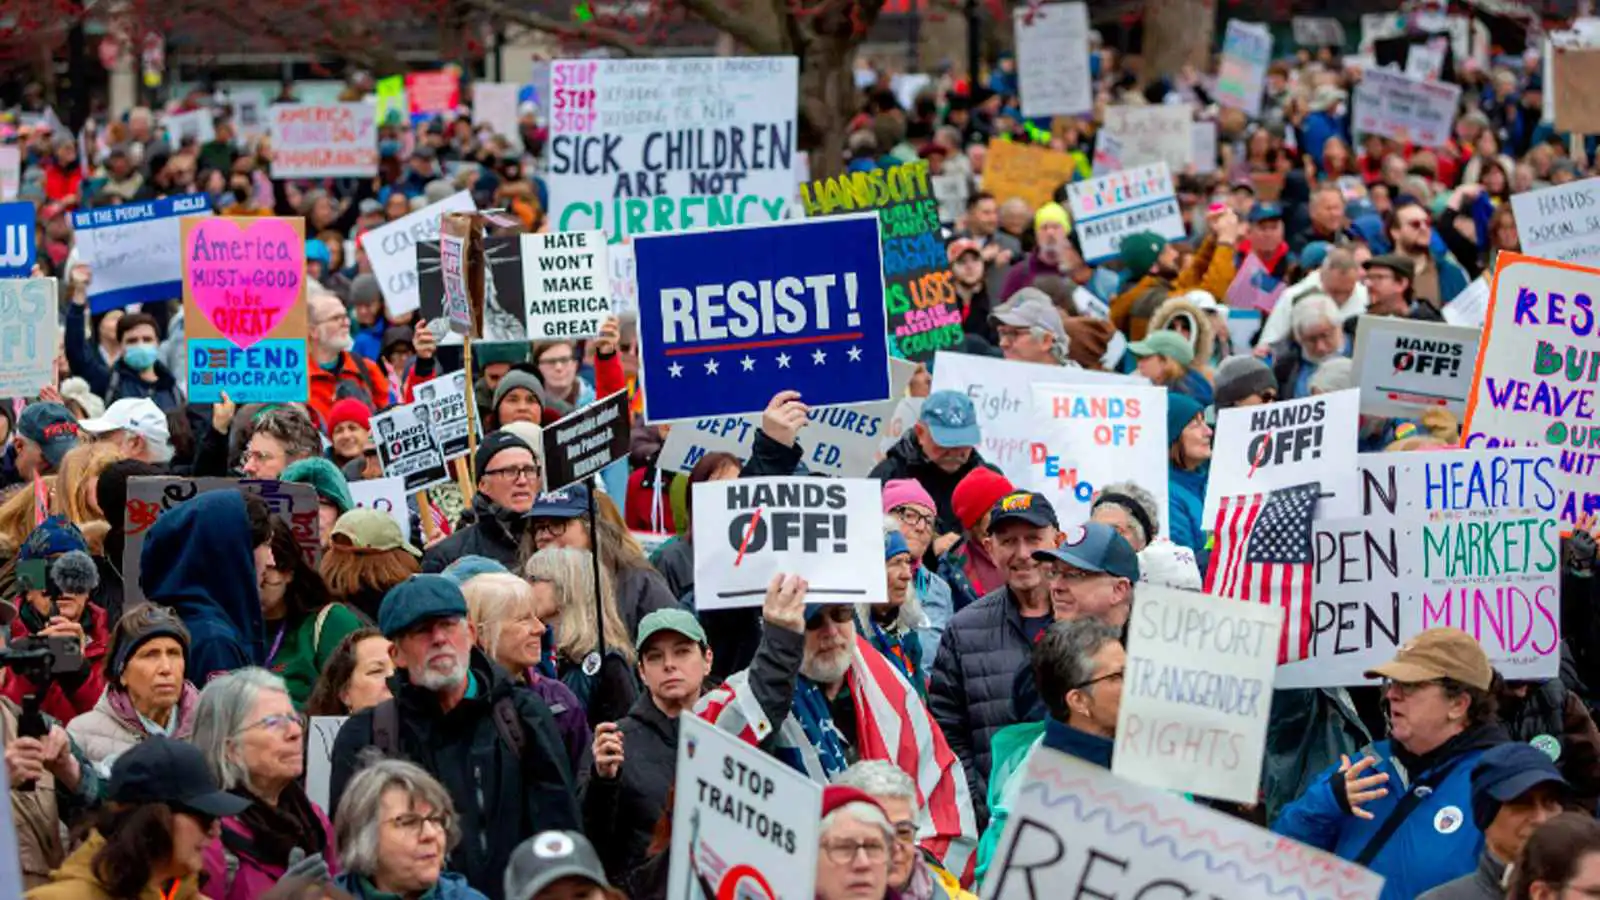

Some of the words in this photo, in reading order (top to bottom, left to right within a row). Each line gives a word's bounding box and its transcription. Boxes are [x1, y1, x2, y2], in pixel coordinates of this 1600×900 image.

[553, 62, 598, 86] STOP
[553, 89, 597, 110] STOP
[553, 112, 597, 133] STOP
[552, 132, 623, 175] SICK
[643, 120, 793, 171] CHILDREN
[614, 172, 667, 197] ARE
[690, 172, 746, 196] NOT
[800, 168, 889, 215] HANDS
[888, 159, 929, 201] OFF
[94, 208, 113, 224] THE
[115, 203, 155, 221] PEOPLE
[1126, 204, 1175, 226] AMERICA
[1537, 188, 1596, 216] HANDS
[559, 195, 785, 244] CURRENCY
[192, 227, 293, 262] America
[544, 233, 587, 250] HATE
[538, 253, 594, 271] WON'T
[193, 268, 238, 288] MUST
[252, 269, 298, 288] GOOD
[543, 276, 593, 292] MAKE
[225, 290, 240, 306] to
[244, 289, 262, 306] be
[530, 296, 610, 316] AMERICA
[660, 272, 862, 344] RESIST!
[212, 307, 280, 337] GREAT
[1513, 286, 1600, 338] RES
[543, 319, 599, 336] GREAT
[902, 323, 965, 355] COURTS
[194, 347, 299, 369] DEFEND
[1395, 337, 1464, 356] HANDS
[191, 371, 303, 386] DEMOCRACY
[1392, 352, 1462, 378] OFF!
[430, 393, 463, 409] HANDS
[967, 384, 1022, 420] Fight
[1052, 397, 1141, 418] HANDS
[1486, 377, 1595, 420] WEAVE
[806, 407, 882, 438] UTURES
[1250, 400, 1326, 431] HANDS
[386, 423, 425, 442] HANDS
[391, 435, 428, 456] OFF!
[1094, 424, 1142, 446] OFF
[1545, 421, 1600, 448] OUR
[813, 443, 843, 469] ED.
[1247, 425, 1324, 468] OFF!
[1029, 442, 1100, 503] DEMO
[1425, 456, 1556, 512] HEARTS
[727, 483, 847, 510] HANDS
[728, 512, 848, 554] OFF!
[1314, 528, 1399, 585] PEN
[1423, 518, 1558, 578] MARKETS
[1137, 600, 1278, 657] SUPPORT
[1313, 591, 1400, 657] PEN
[1422, 585, 1559, 656] MINDS
[1129, 656, 1264, 719] TRANSGENDER
[1119, 713, 1247, 771] RIGHTS
[722, 755, 775, 801] STOP
[696, 776, 798, 856] TRAITORS
